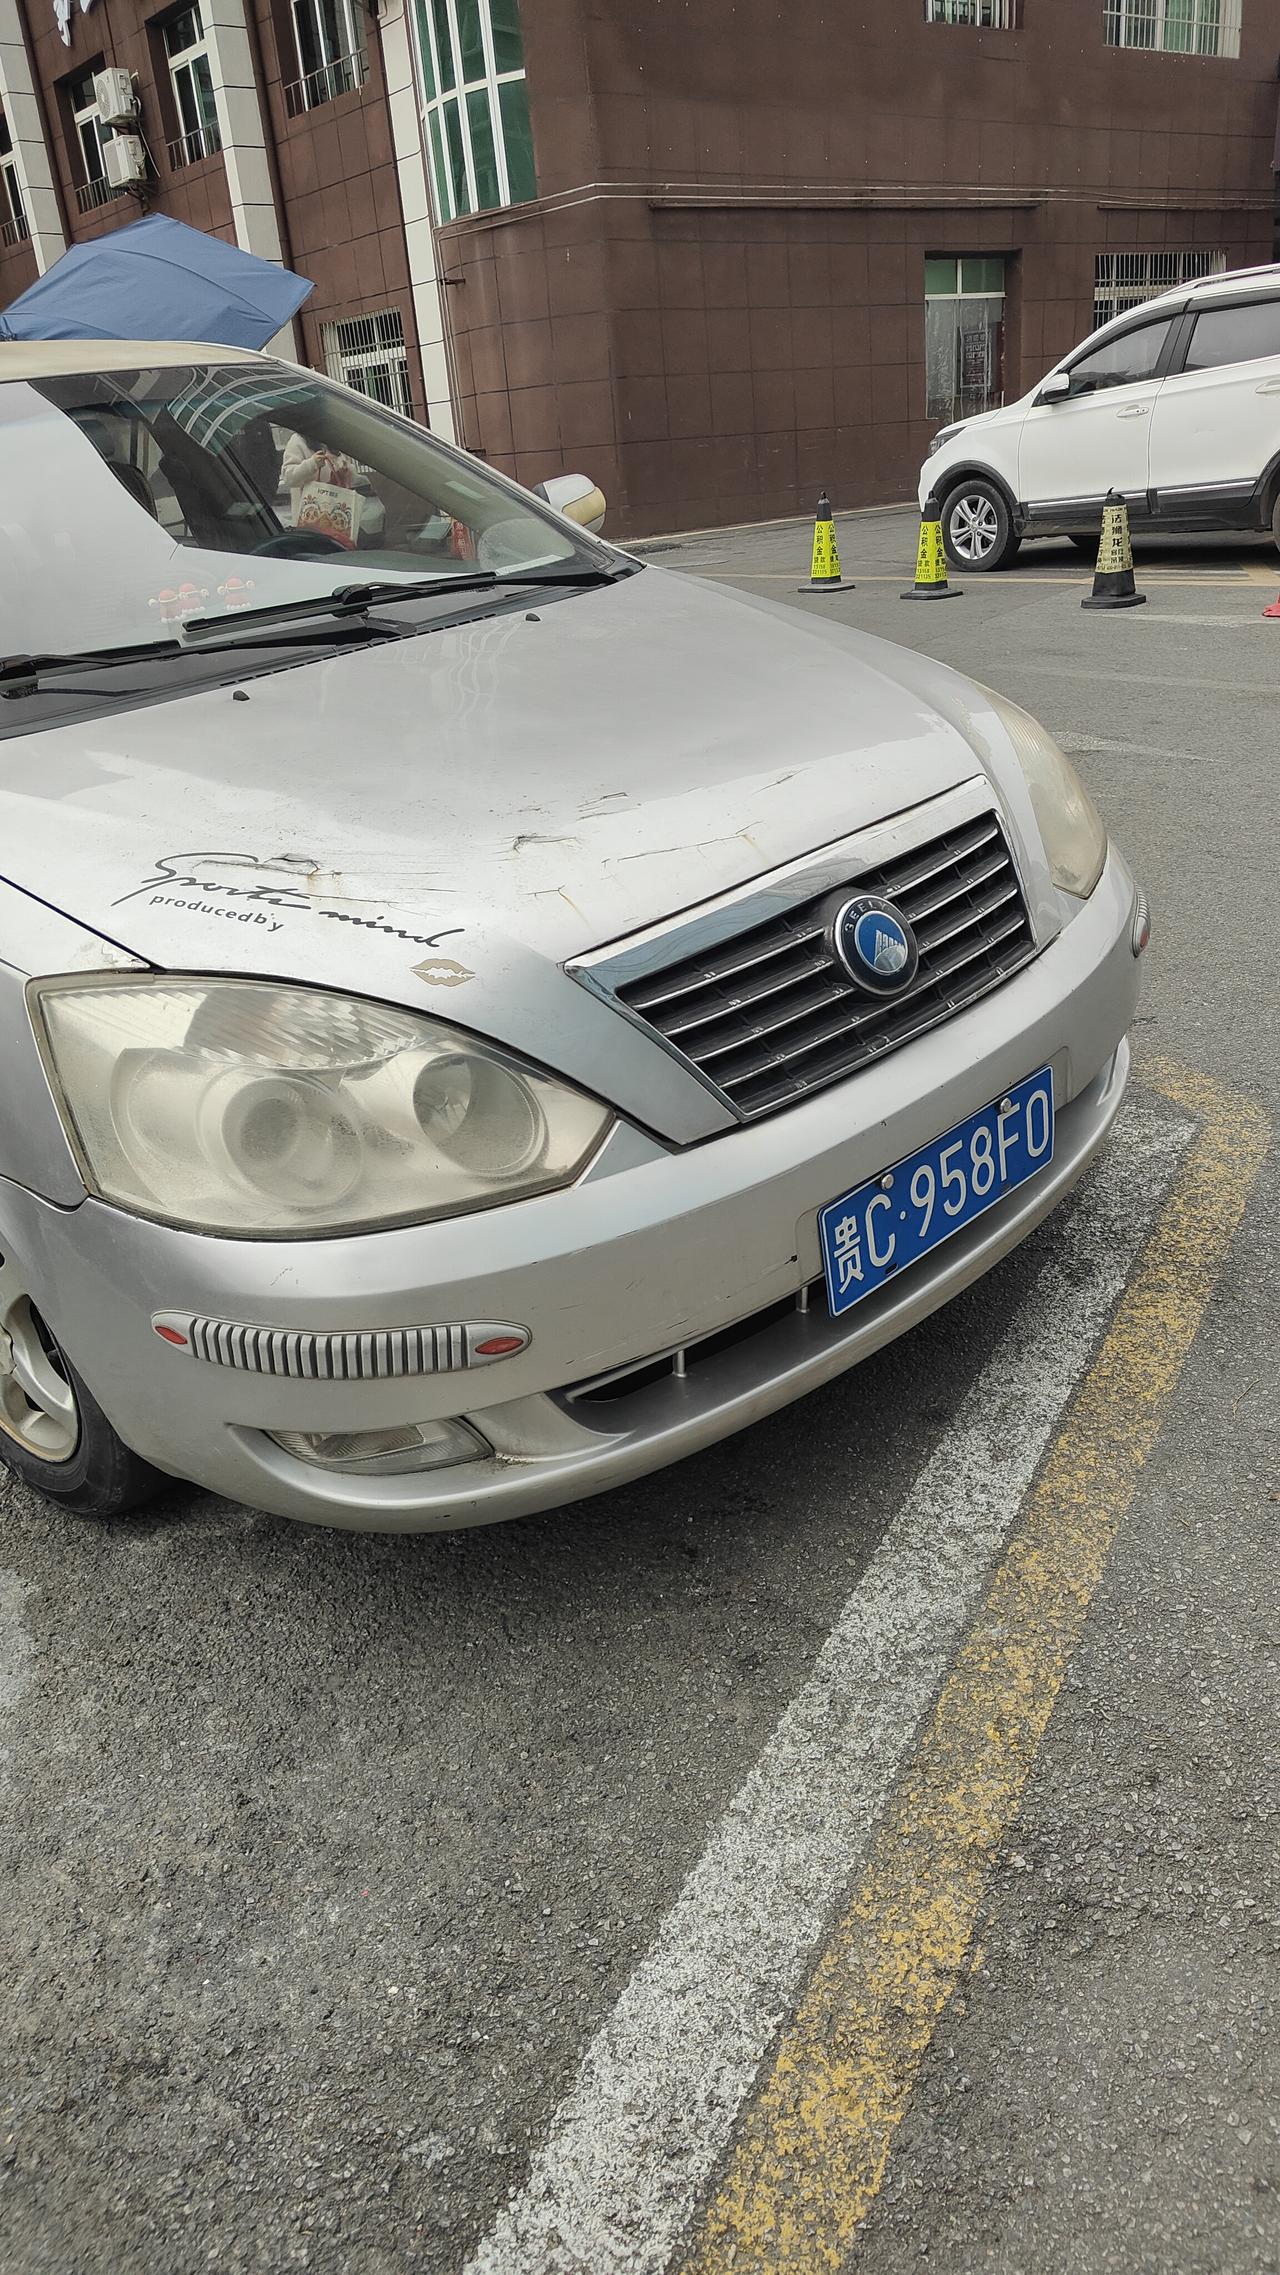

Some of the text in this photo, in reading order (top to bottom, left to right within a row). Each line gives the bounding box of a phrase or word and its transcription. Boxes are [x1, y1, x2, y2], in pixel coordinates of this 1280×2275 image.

[816, 524, 824, 556] 公积金
[828, 523, 838, 555] 公积金
[921, 525, 929, 559] 公积金
[935, 524, 943, 558] 公积金
[318, 910, 466, 948] mind
[845, 900, 887, 933] GEELY
